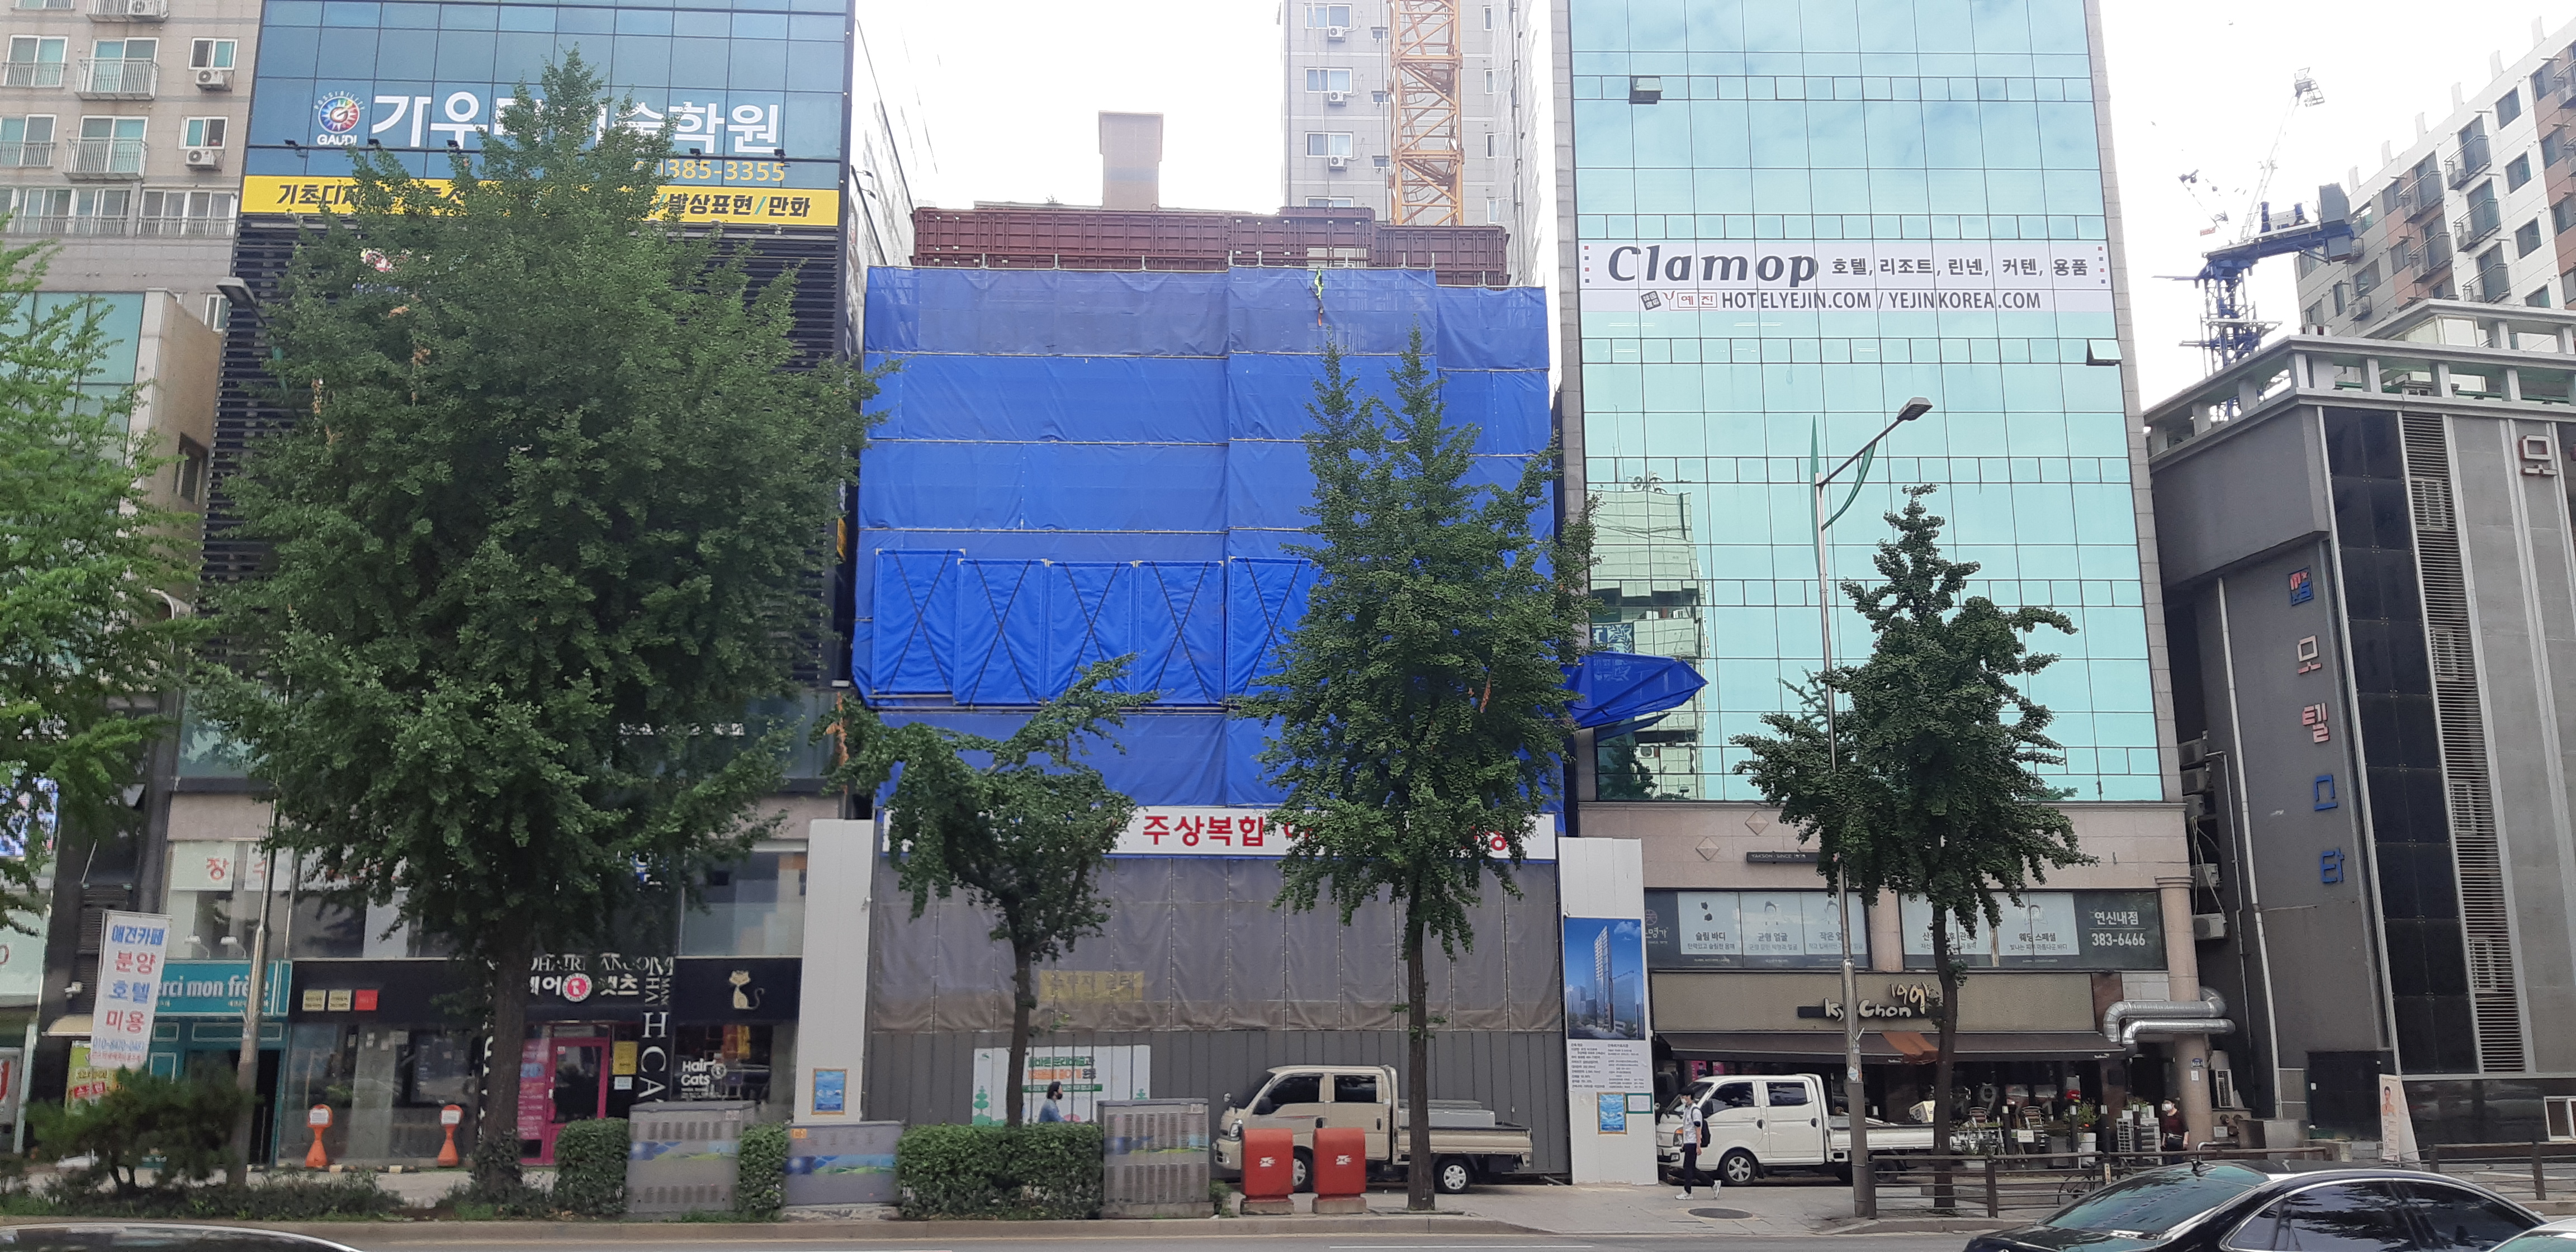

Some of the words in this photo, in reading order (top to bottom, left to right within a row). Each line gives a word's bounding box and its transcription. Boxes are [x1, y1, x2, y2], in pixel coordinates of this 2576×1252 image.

[314, 90, 366, 111] POSSIBILITY
[317, 134, 357, 146] GAUDI
[1608, 244, 1819, 288] Clamop
[1831, 258, 1873, 276] 호텔,
[1879, 258, 1942, 276] 리조트,
[1948, 258, 1990, 277] 린넨,
[2002, 258, 2043, 277] 커텐,
[2053, 259, 2089, 276] 용품
[1722, 291, 1871, 309] HOTELYEJIN.COM
[1143, 815, 1264, 847] 주상복합
[2094, 911, 2139, 925] 연신내점
[1696, 932, 1710, 941] 슬림
[1711, 932, 1726, 941] 바디
[2091, 933, 2146, 946] 383-6466
[115, 951, 156, 975] 분양
[108, 980, 151, 1004] 호텔
[187, 980, 224, 997] mon
[106, 1010, 145, 1034] 미용
[682, 1057, 716, 1072] Hair
[681, 1073, 711, 1086] Cats
